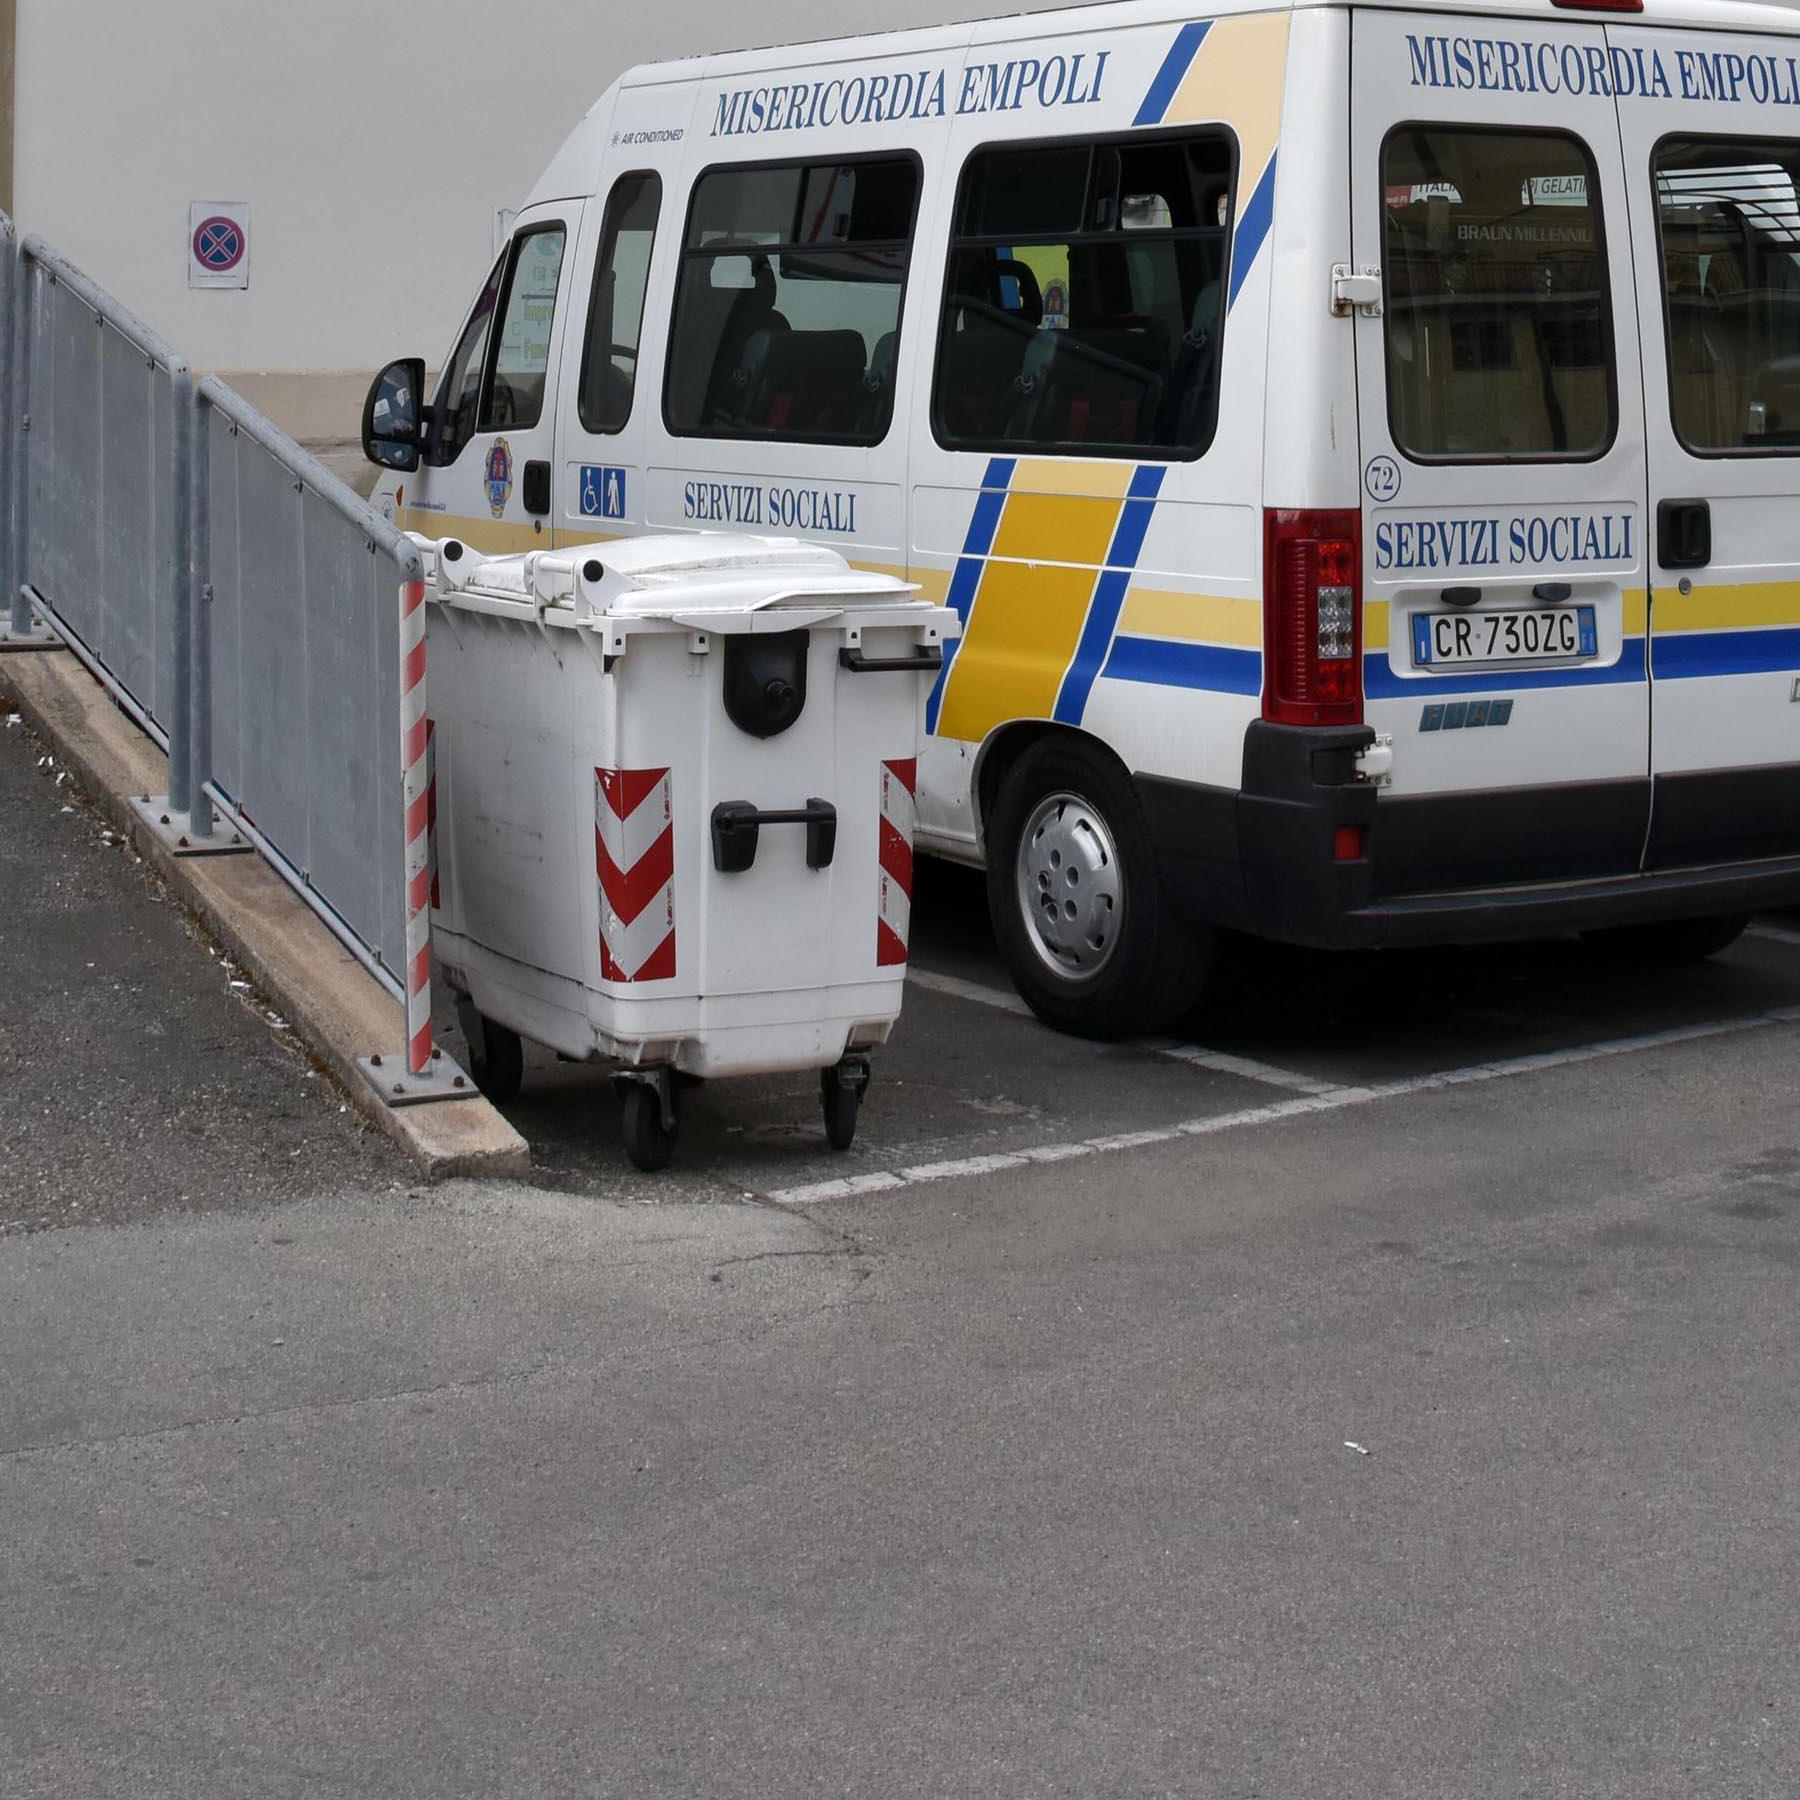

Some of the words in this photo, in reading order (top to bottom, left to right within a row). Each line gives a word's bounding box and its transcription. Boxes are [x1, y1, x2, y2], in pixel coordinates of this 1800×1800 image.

[1405, 34, 1673, 99] MISERICORDIA
[709, 68, 947, 138] MISERICORDIA
[955, 50, 1111, 116] EMPOLI
[621, 132, 634, 144] AIR
[635, 128, 684, 143] CONDITIONED
[1457, 225, 1513, 241] BRAUN
[1370, 466, 1394, 491] 72
[684, 481, 763, 524] SERVIZI
[768, 487, 857, 533] SOCIALI
[1375, 519, 1500, 570] SERVIZI
[1509, 515, 1633, 564] SOCIALI
[1434, 616, 1473, 658] CR
[1484, 613, 1576, 655] 730ZG
[1418, 698, 1514, 733] FIAT
